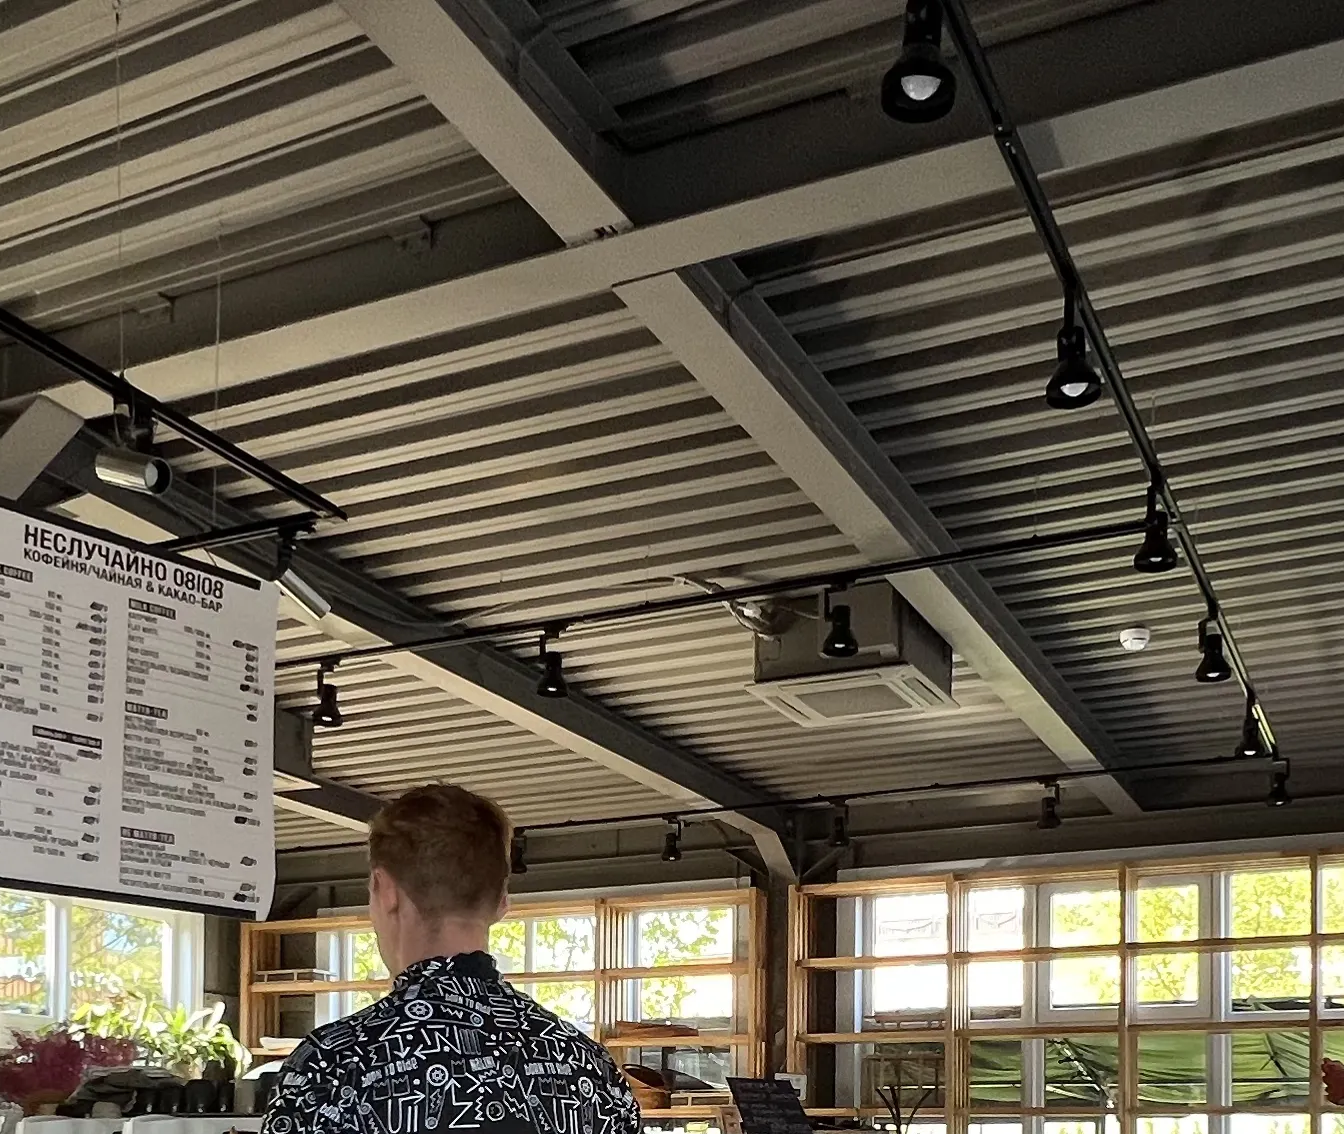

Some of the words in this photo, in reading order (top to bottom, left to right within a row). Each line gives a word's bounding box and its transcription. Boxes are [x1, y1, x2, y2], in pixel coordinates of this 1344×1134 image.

[23, 546, 141, 590] КОФЕЙНЯ/ЧАЙНАЯ
[146, 580, 154, 593] &
[157, 584, 223, 614] КАКАО-БАР
[24, 523, 166, 584] НЕСЛУЧАЙНО
